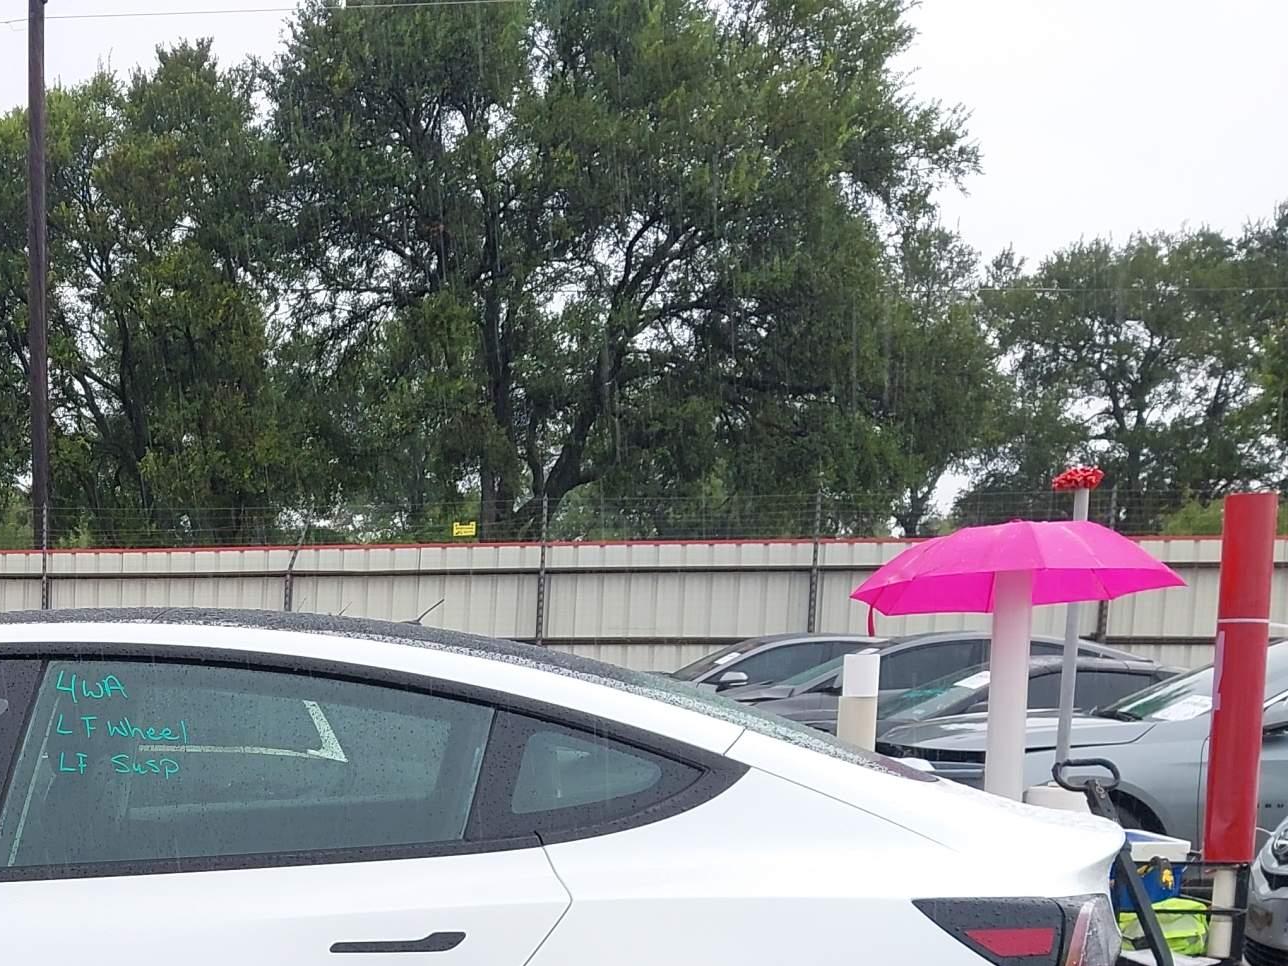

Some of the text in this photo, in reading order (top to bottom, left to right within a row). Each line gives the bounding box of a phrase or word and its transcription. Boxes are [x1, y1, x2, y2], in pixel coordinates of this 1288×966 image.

[106, 717, 188, 744] Wheel
[58, 752, 180, 779] LF Susp
